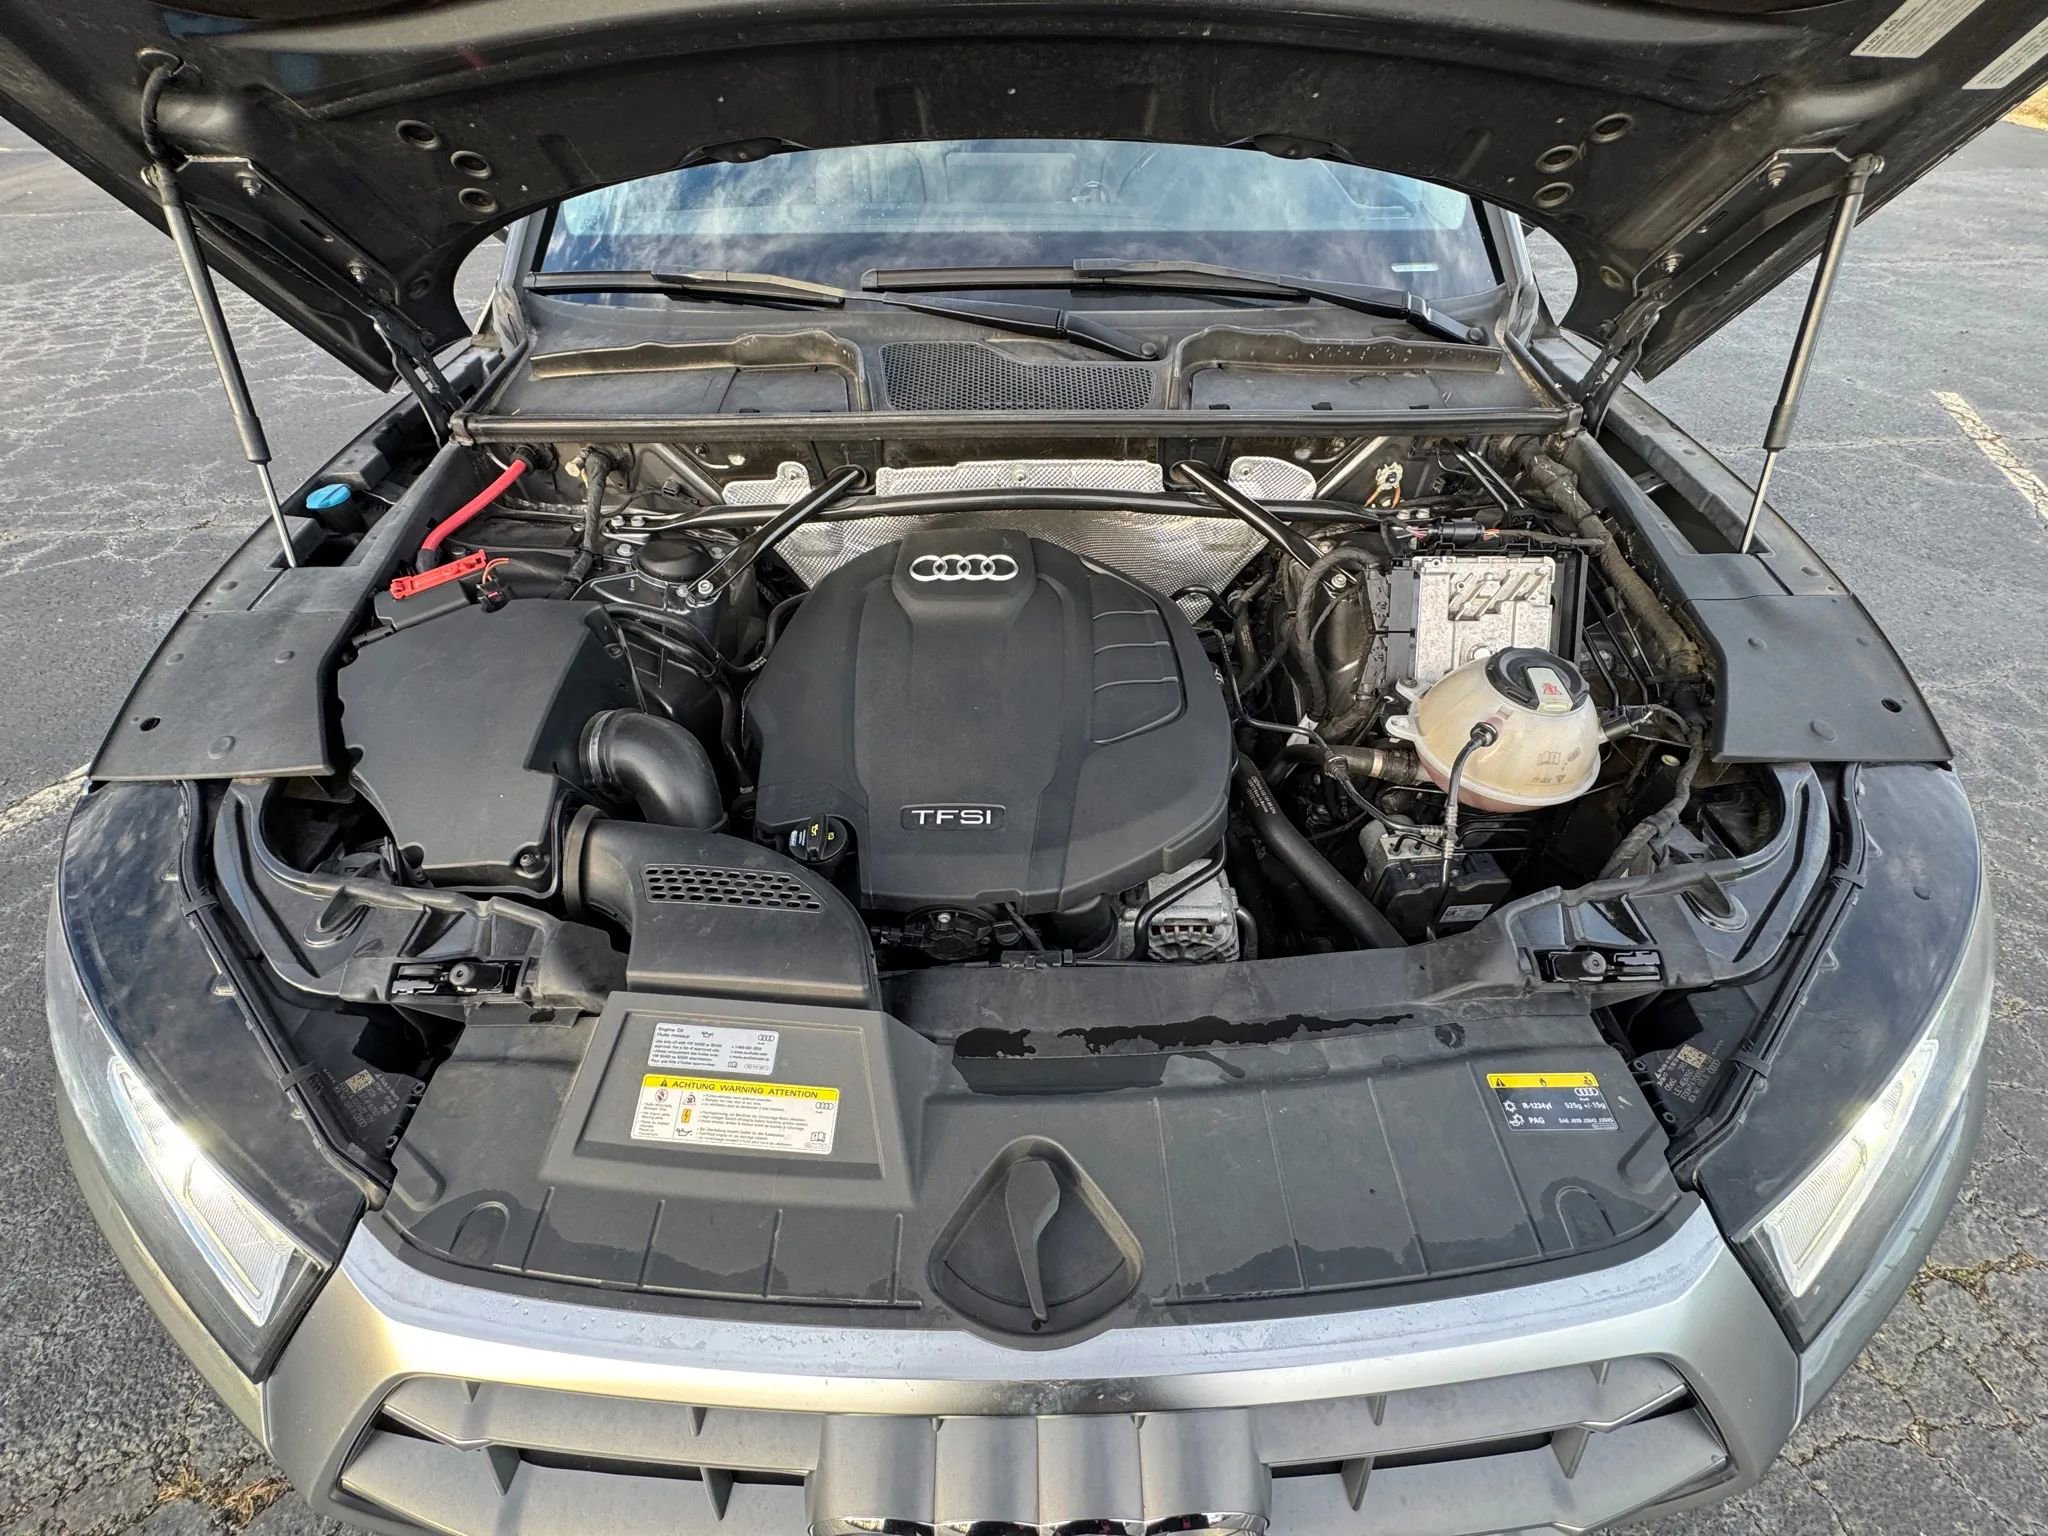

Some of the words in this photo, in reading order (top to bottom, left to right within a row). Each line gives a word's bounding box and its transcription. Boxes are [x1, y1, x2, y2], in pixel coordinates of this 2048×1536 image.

[1531, 776, 1553, 784] max
[911, 809, 992, 825] TFSI
[671, 1081, 716, 1092] ACHTUNG
[720, 1084, 764, 1095] WARNING
[768, 1088, 818, 1099] ATTENTION
[1521, 1102, 1553, 1110] R-1234yf
[1564, 1102, 1583, 1110] 525g
[1528, 1116, 1546, 1124] PAG
